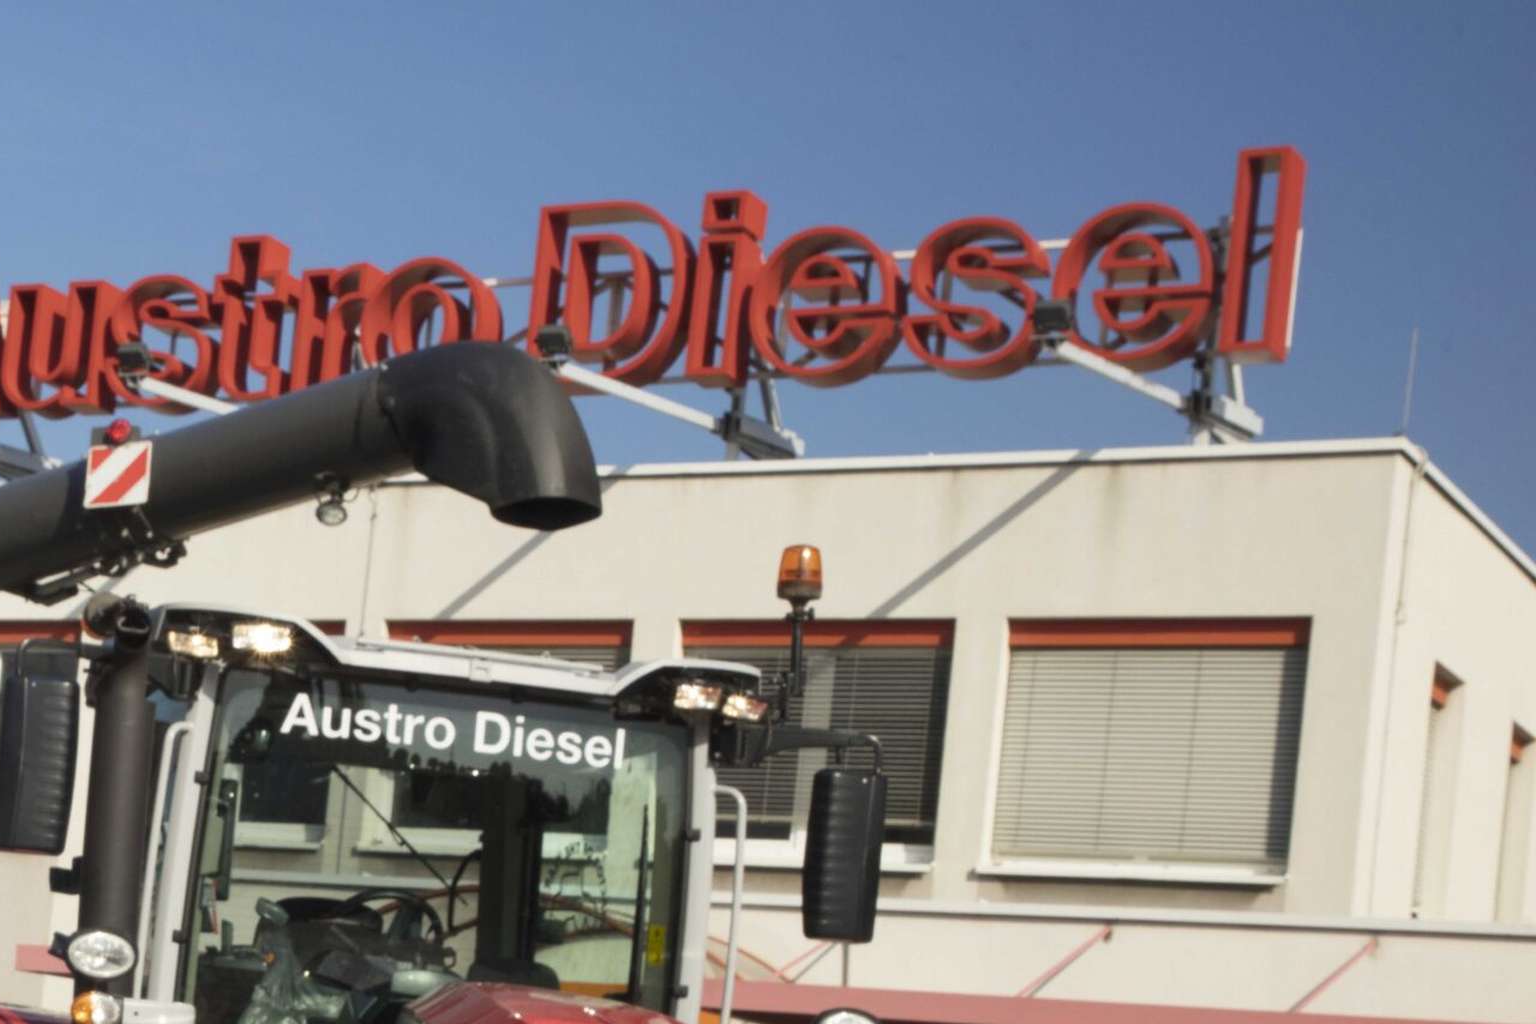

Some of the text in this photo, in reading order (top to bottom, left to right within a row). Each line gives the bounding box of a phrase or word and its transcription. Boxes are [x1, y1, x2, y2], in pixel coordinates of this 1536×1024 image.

[528, 145, 1307, 393] Diesel
[279, 692, 626, 770] Austro Diesel
